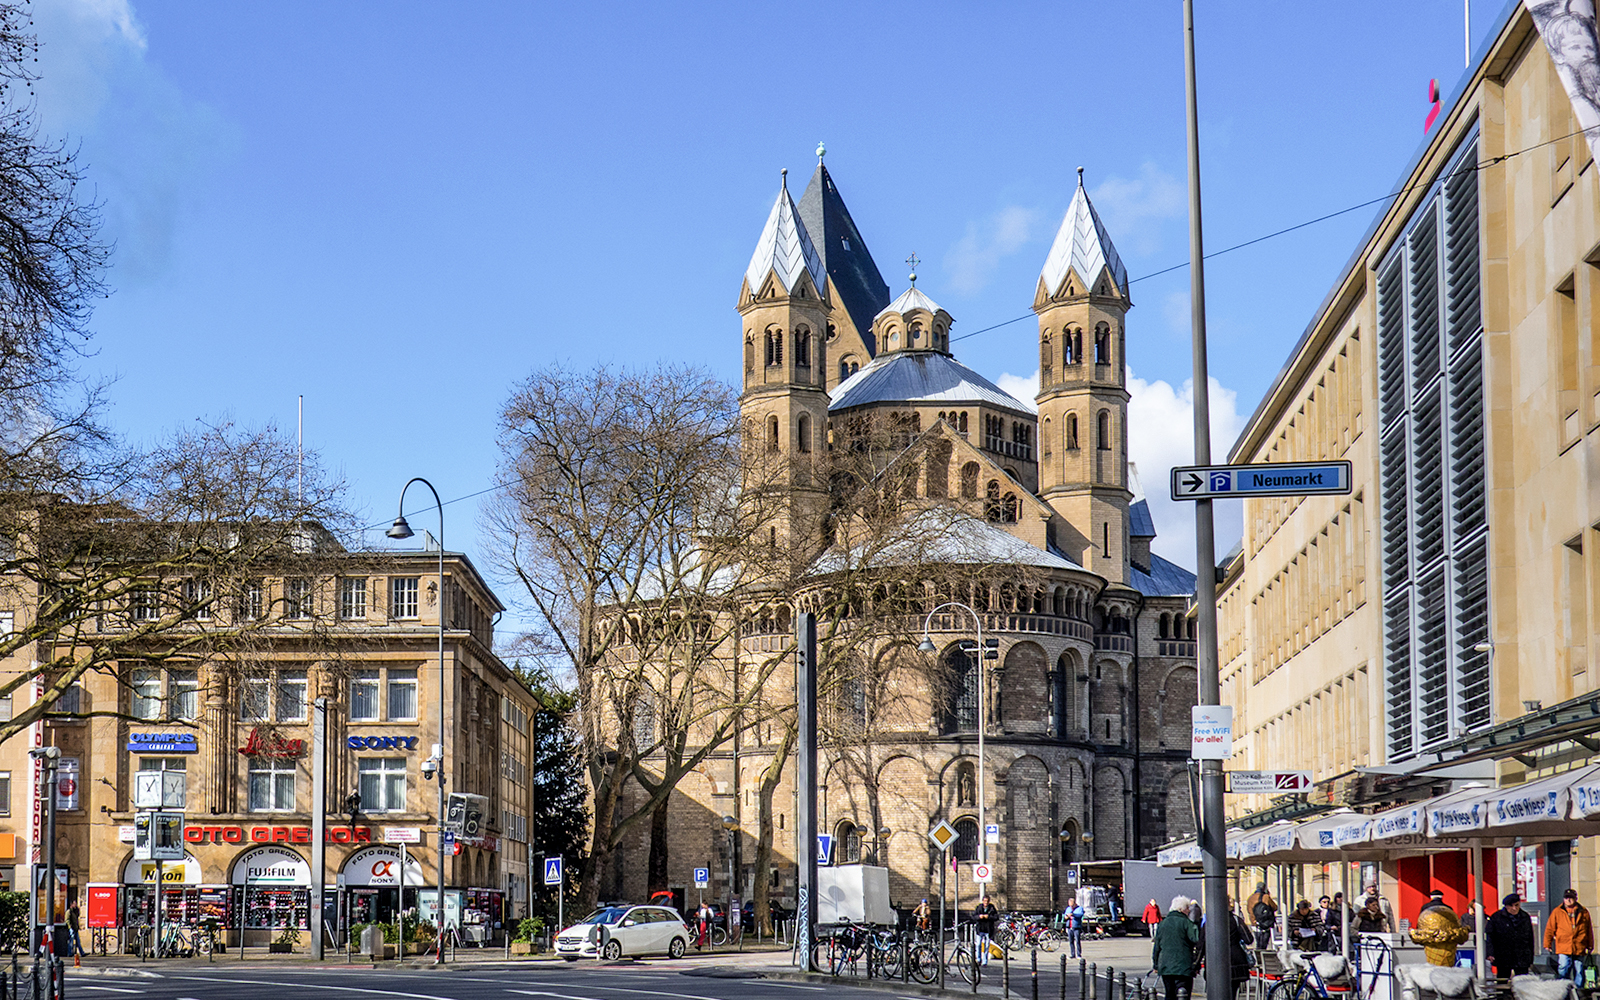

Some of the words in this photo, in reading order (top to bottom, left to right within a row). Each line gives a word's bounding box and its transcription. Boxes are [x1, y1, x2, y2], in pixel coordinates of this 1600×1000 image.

[1253, 472, 1323, 487] Neumarkt
[34, 688, 44, 748] FTO
[129, 733, 195, 742] OLYMPUS
[347, 736, 416, 748] SONY
[1506, 798, 1524, 818] Café
[1523, 797, 1545, 816] Riese
[1395, 815, 1409, 830] Riese
[1440, 811, 1454, 828] Café
[1453, 809, 1471, 826] Riese
[183, 827, 242, 842] OTO
[268, 848, 301, 863] GREGOR
[352, 850, 375, 865] FOTO
[144, 870, 182, 881] Nkon
[248, 867, 296, 877] FUJIFILM
[697, 869, 706, 881] P
